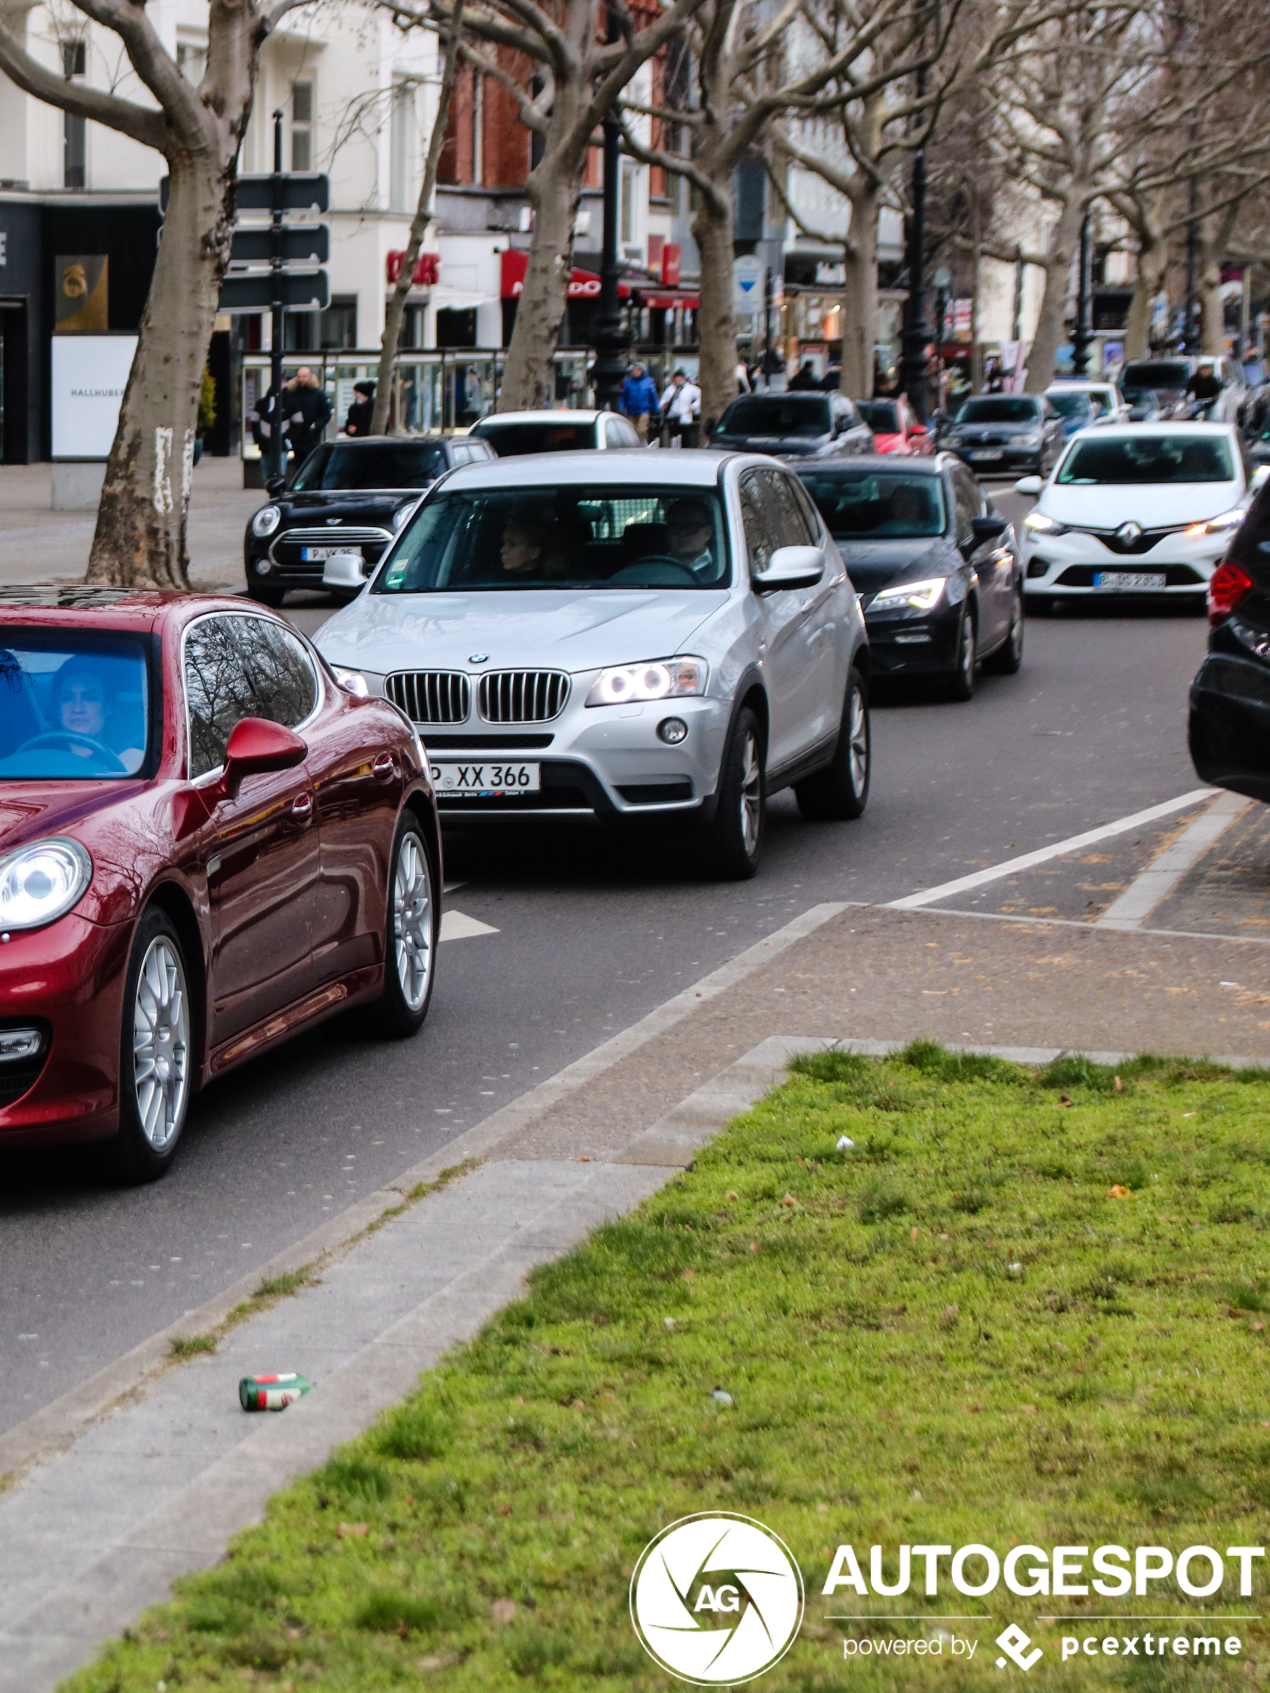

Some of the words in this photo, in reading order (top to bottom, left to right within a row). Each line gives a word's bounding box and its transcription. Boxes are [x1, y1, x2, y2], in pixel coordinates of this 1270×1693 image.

[313, 549, 319, 558] P
[457, 766, 484, 787] XX
[490, 766, 530, 787] 366
